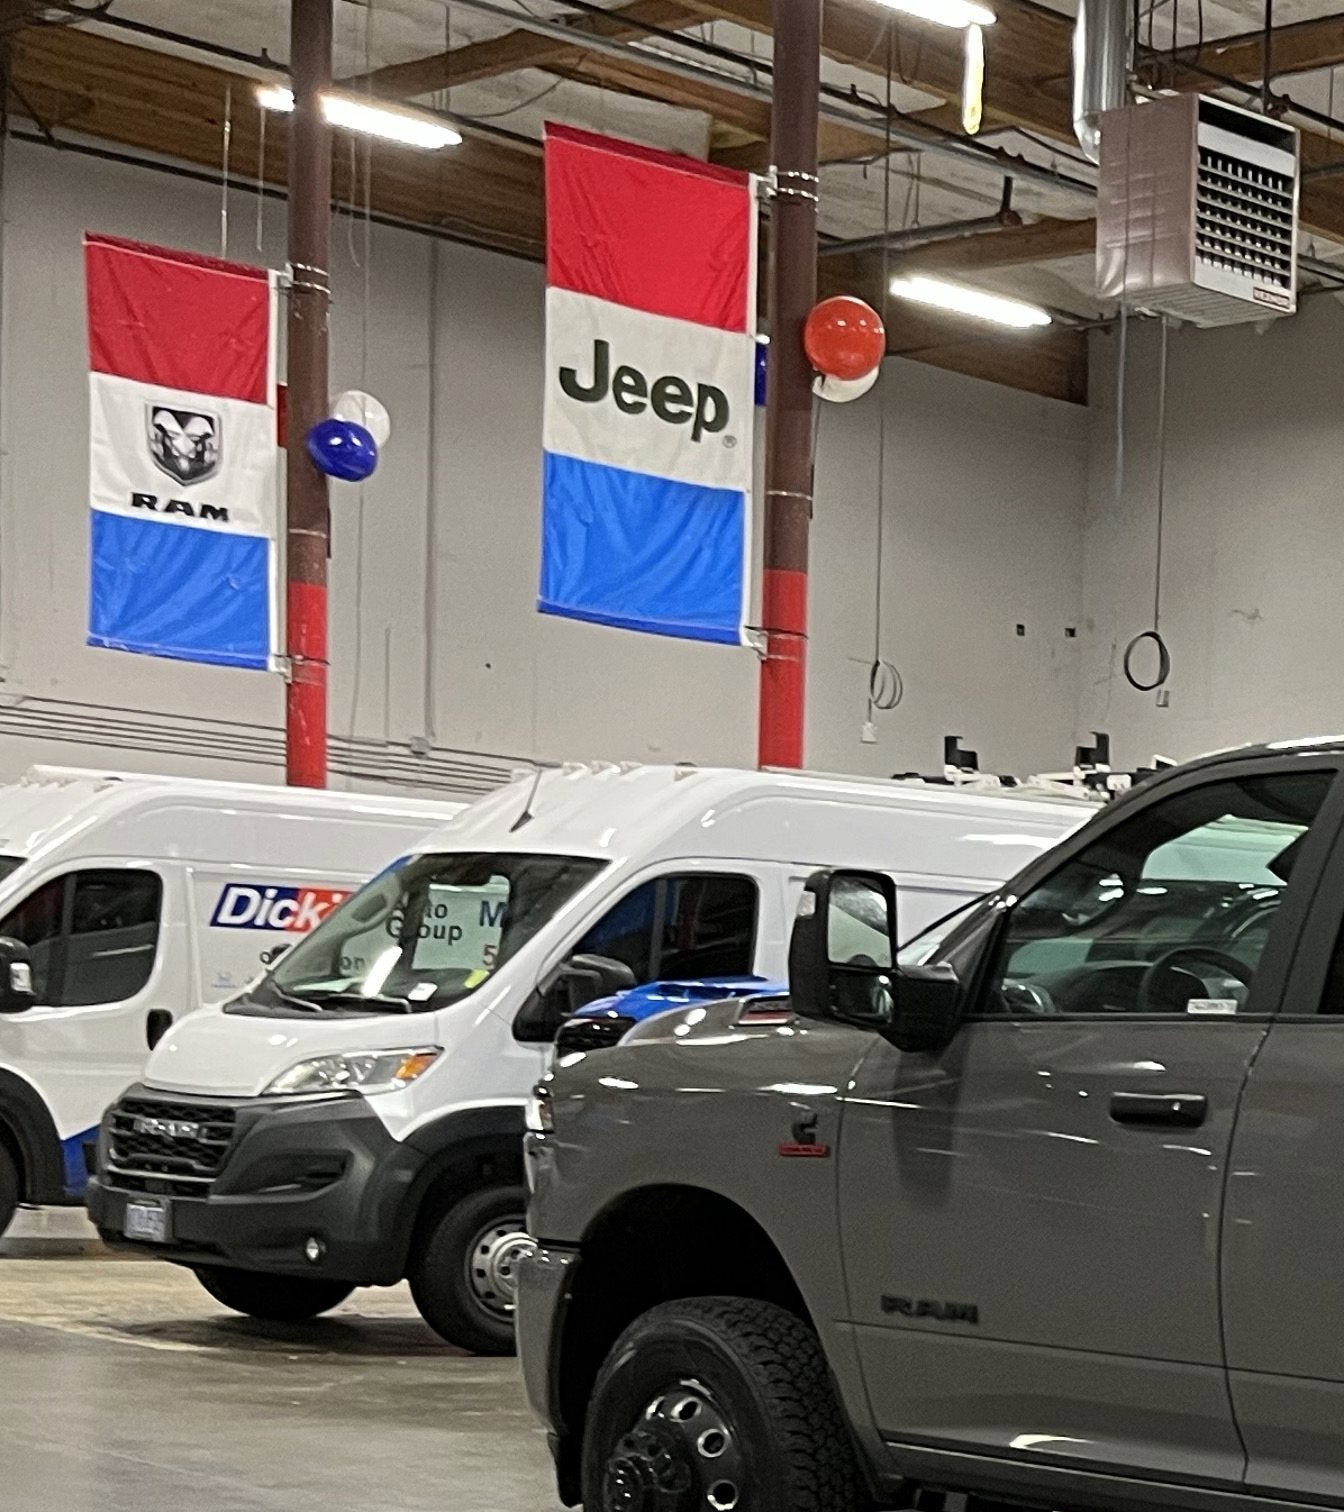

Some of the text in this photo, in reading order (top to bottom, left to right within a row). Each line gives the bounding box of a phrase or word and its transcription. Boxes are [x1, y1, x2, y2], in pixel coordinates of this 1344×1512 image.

[558, 340, 731, 443] Jeep
[131, 492, 230, 523] RAM
[386, 915, 463, 946] Goup
[880, 1295, 979, 1325] RAM
